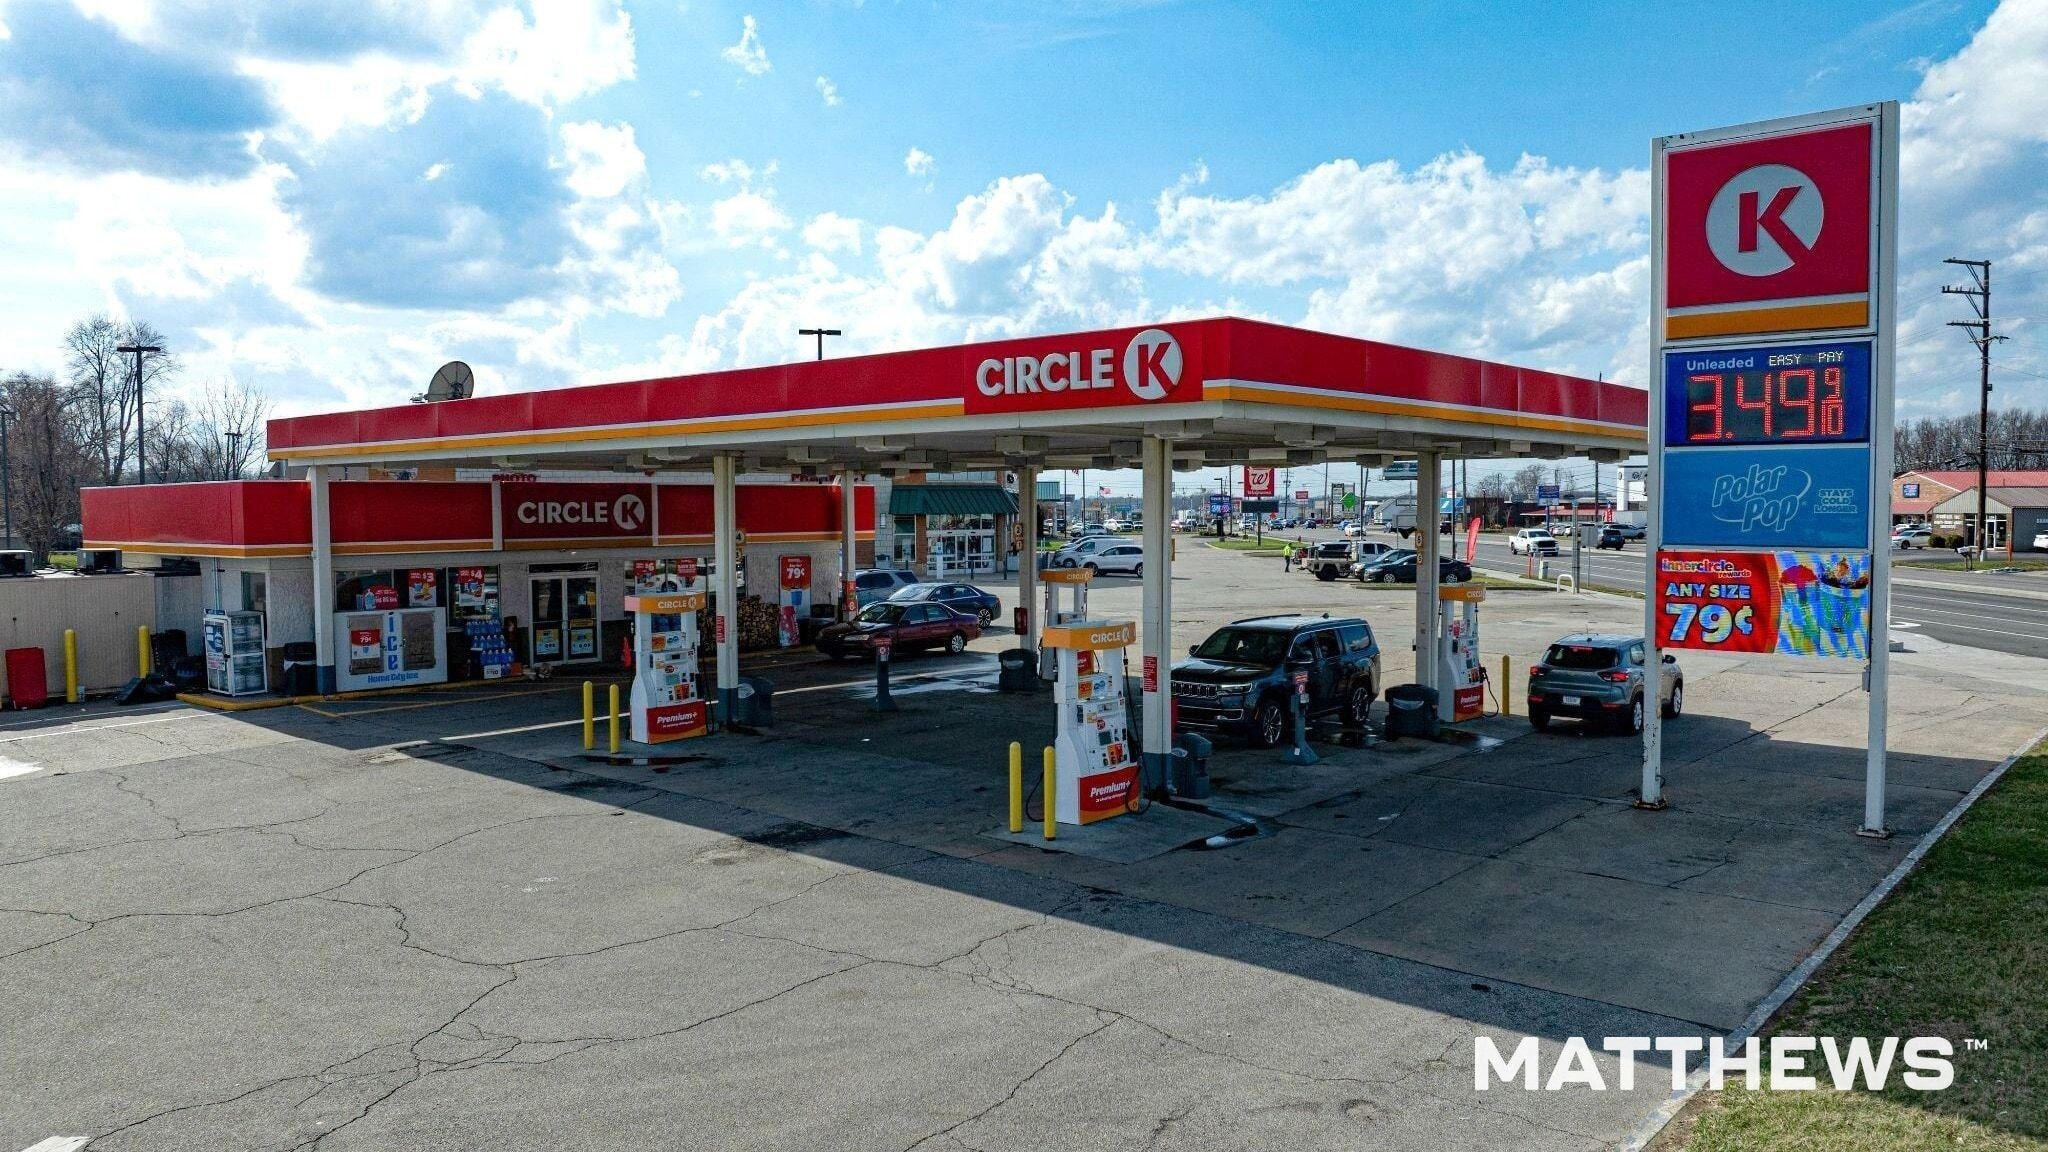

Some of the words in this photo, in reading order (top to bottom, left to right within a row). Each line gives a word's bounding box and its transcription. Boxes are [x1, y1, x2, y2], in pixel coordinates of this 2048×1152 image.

[1686, 357, 1754, 371] Unleaded
[1769, 354, 1802, 366] EASY
[1818, 351, 1844, 363] PAY
[976, 349, 1115, 397] CIRCLE
[1690, 369, 1816, 440] 3.49
[1711, 463, 1788, 508] Polar
[1818, 488, 1855, 498] STAYS
[1813, 504, 1859, 514] LONGER
[1821, 497, 1852, 506] COLD
[517, 501, 608, 524] CIRCLE
[1741, 495, 1800, 533] Pop
[1718, 569, 1751, 579] rewards
[1665, 582, 1706, 598] ANY
[1709, 584, 1751, 599] SIZE
[657, 600, 687, 609] CIRCLE
[1665, 602, 1754, 644] 79¢
[387, 612, 398, 671] ice
[1090, 631, 1121, 644] CIRCLE
[1090, 780, 1131, 798] Premium+
